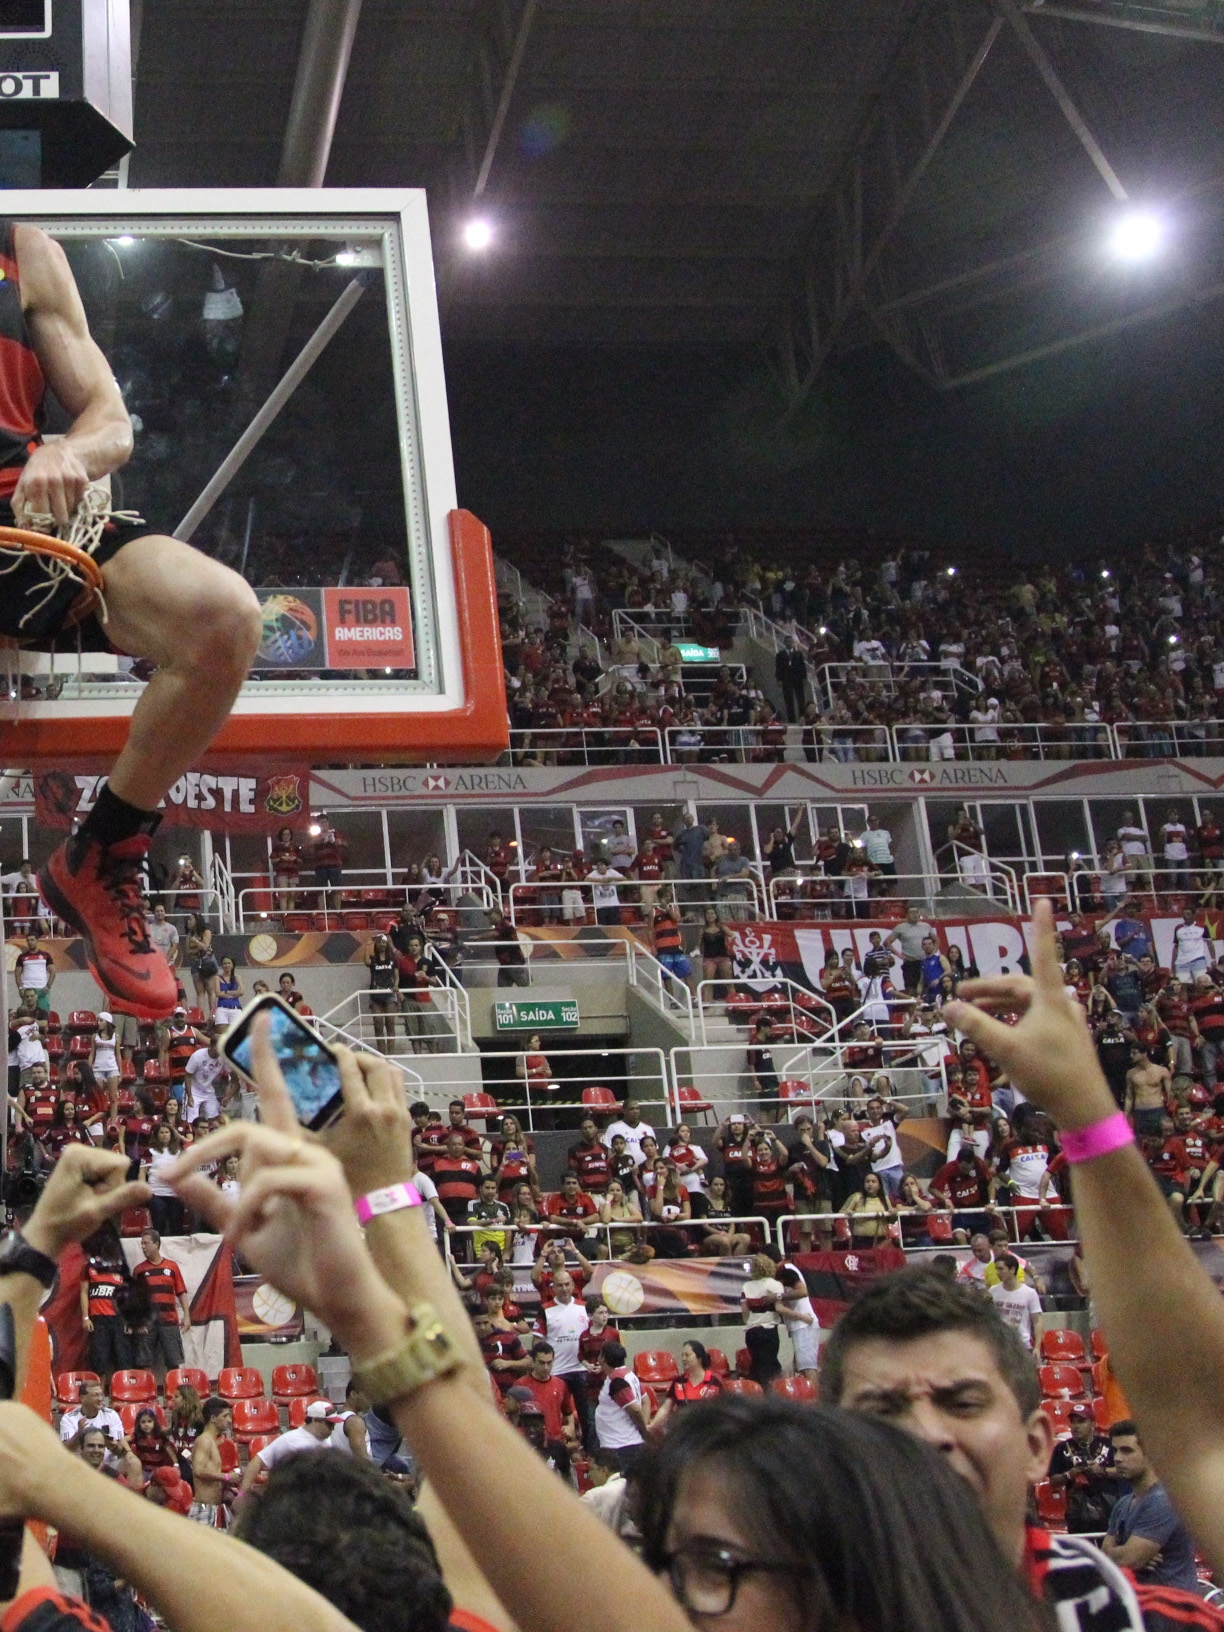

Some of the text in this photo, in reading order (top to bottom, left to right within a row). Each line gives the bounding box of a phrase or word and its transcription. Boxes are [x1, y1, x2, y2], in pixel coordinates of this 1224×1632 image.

[338, 598, 396, 625] FIBA
[334, 626, 404, 641] AMERICAS
[362, 773, 528, 793] HSBC ARENA
[851, 767, 1009, 787] HSBC ARENA
[169, 772, 257, 814] OESTE
[498, 1008, 578, 1024] 101 SAÍDA 102
